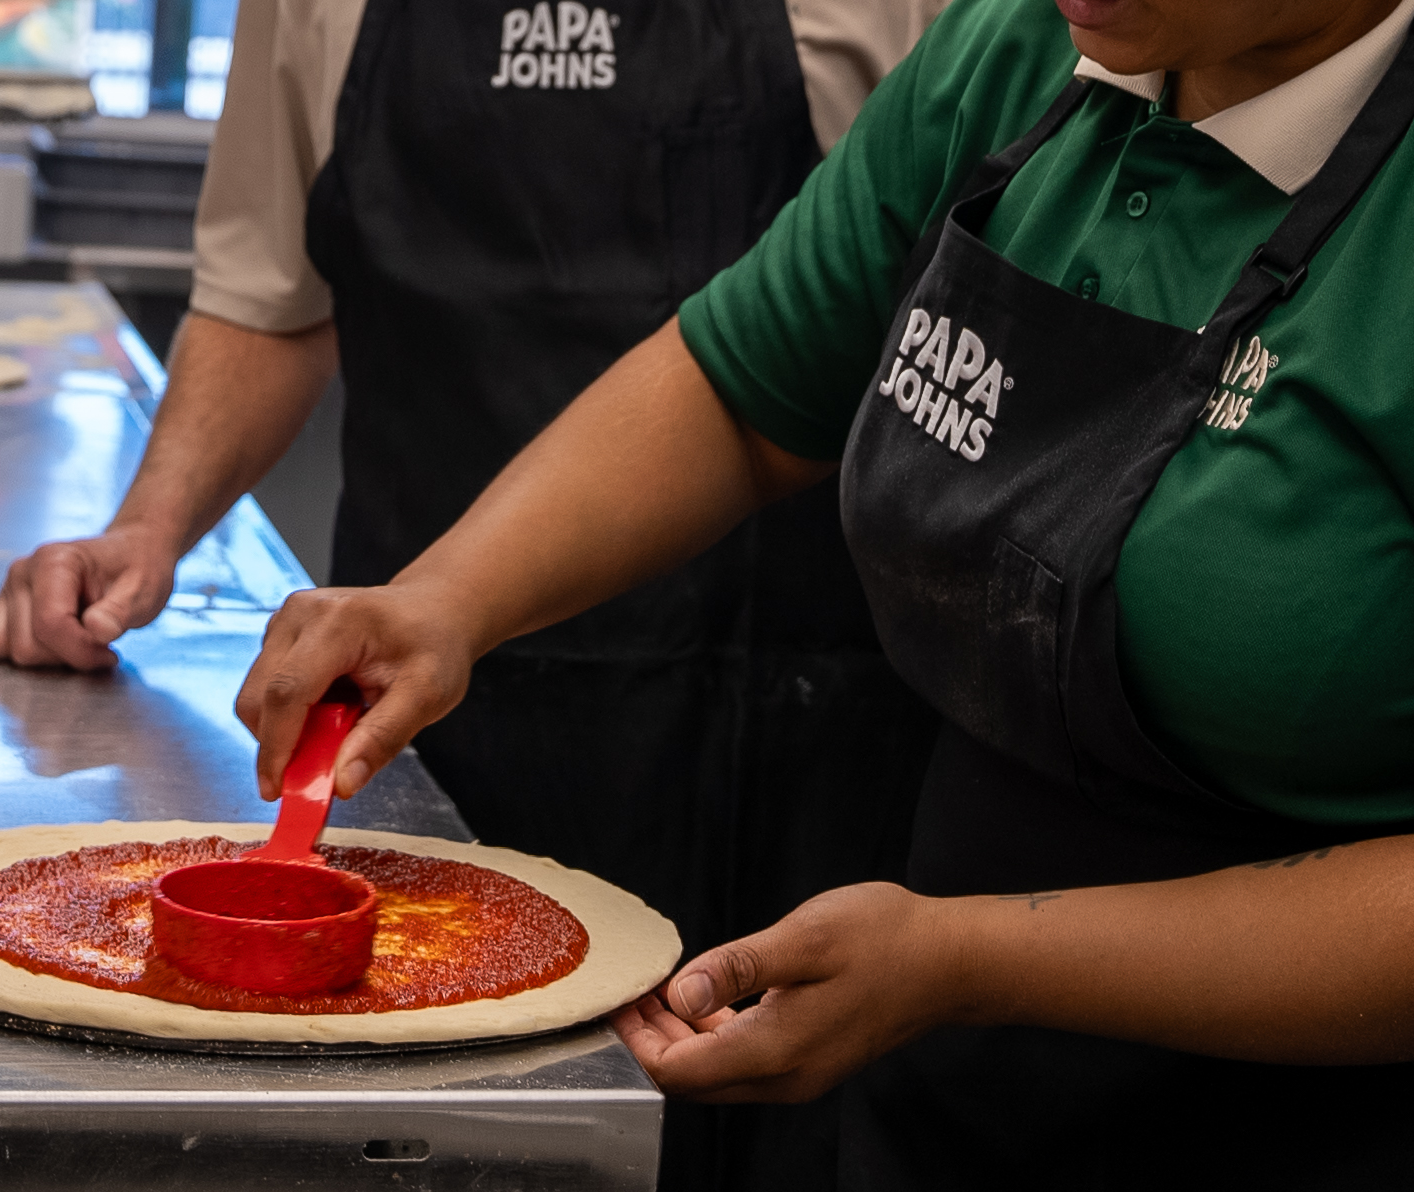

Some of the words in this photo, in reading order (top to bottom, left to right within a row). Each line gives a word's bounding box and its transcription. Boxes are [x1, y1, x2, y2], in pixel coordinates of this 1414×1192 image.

[500, 0, 616, 52] PAPA
[490, 51, 618, 89] JOHNS
[879, 357, 993, 462] JOHNS
